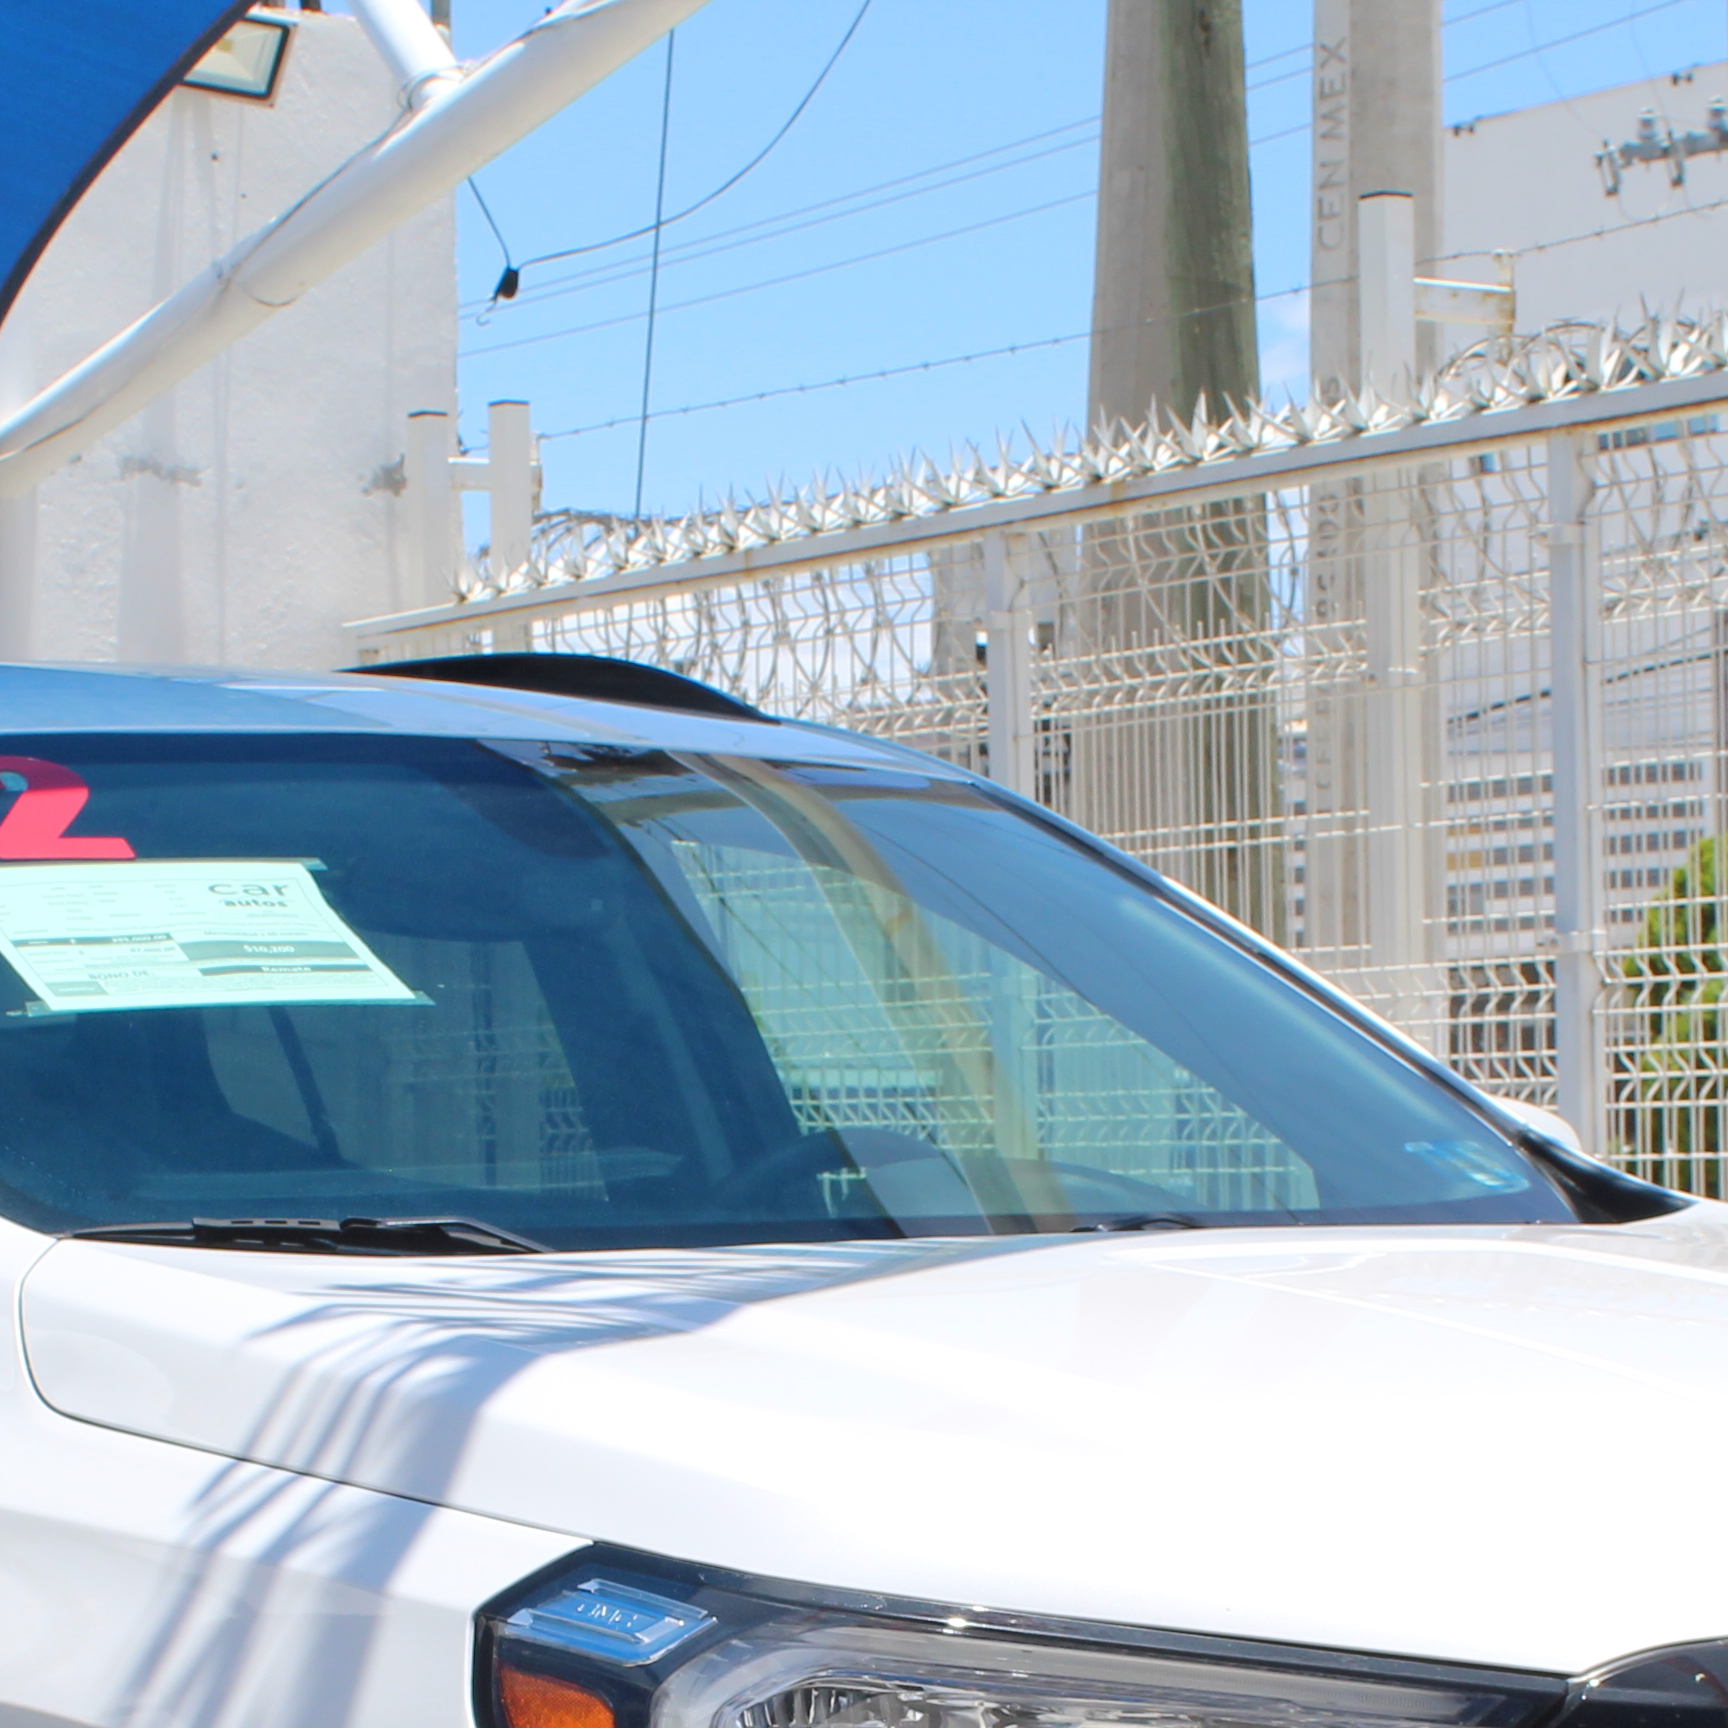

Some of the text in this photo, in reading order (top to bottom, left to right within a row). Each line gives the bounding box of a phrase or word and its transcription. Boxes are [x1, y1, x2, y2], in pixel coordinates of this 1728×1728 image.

[1320, 36, 1348, 140] MEX
[1318, 158, 1345, 248] CEN
[208, 882, 289, 898] car
